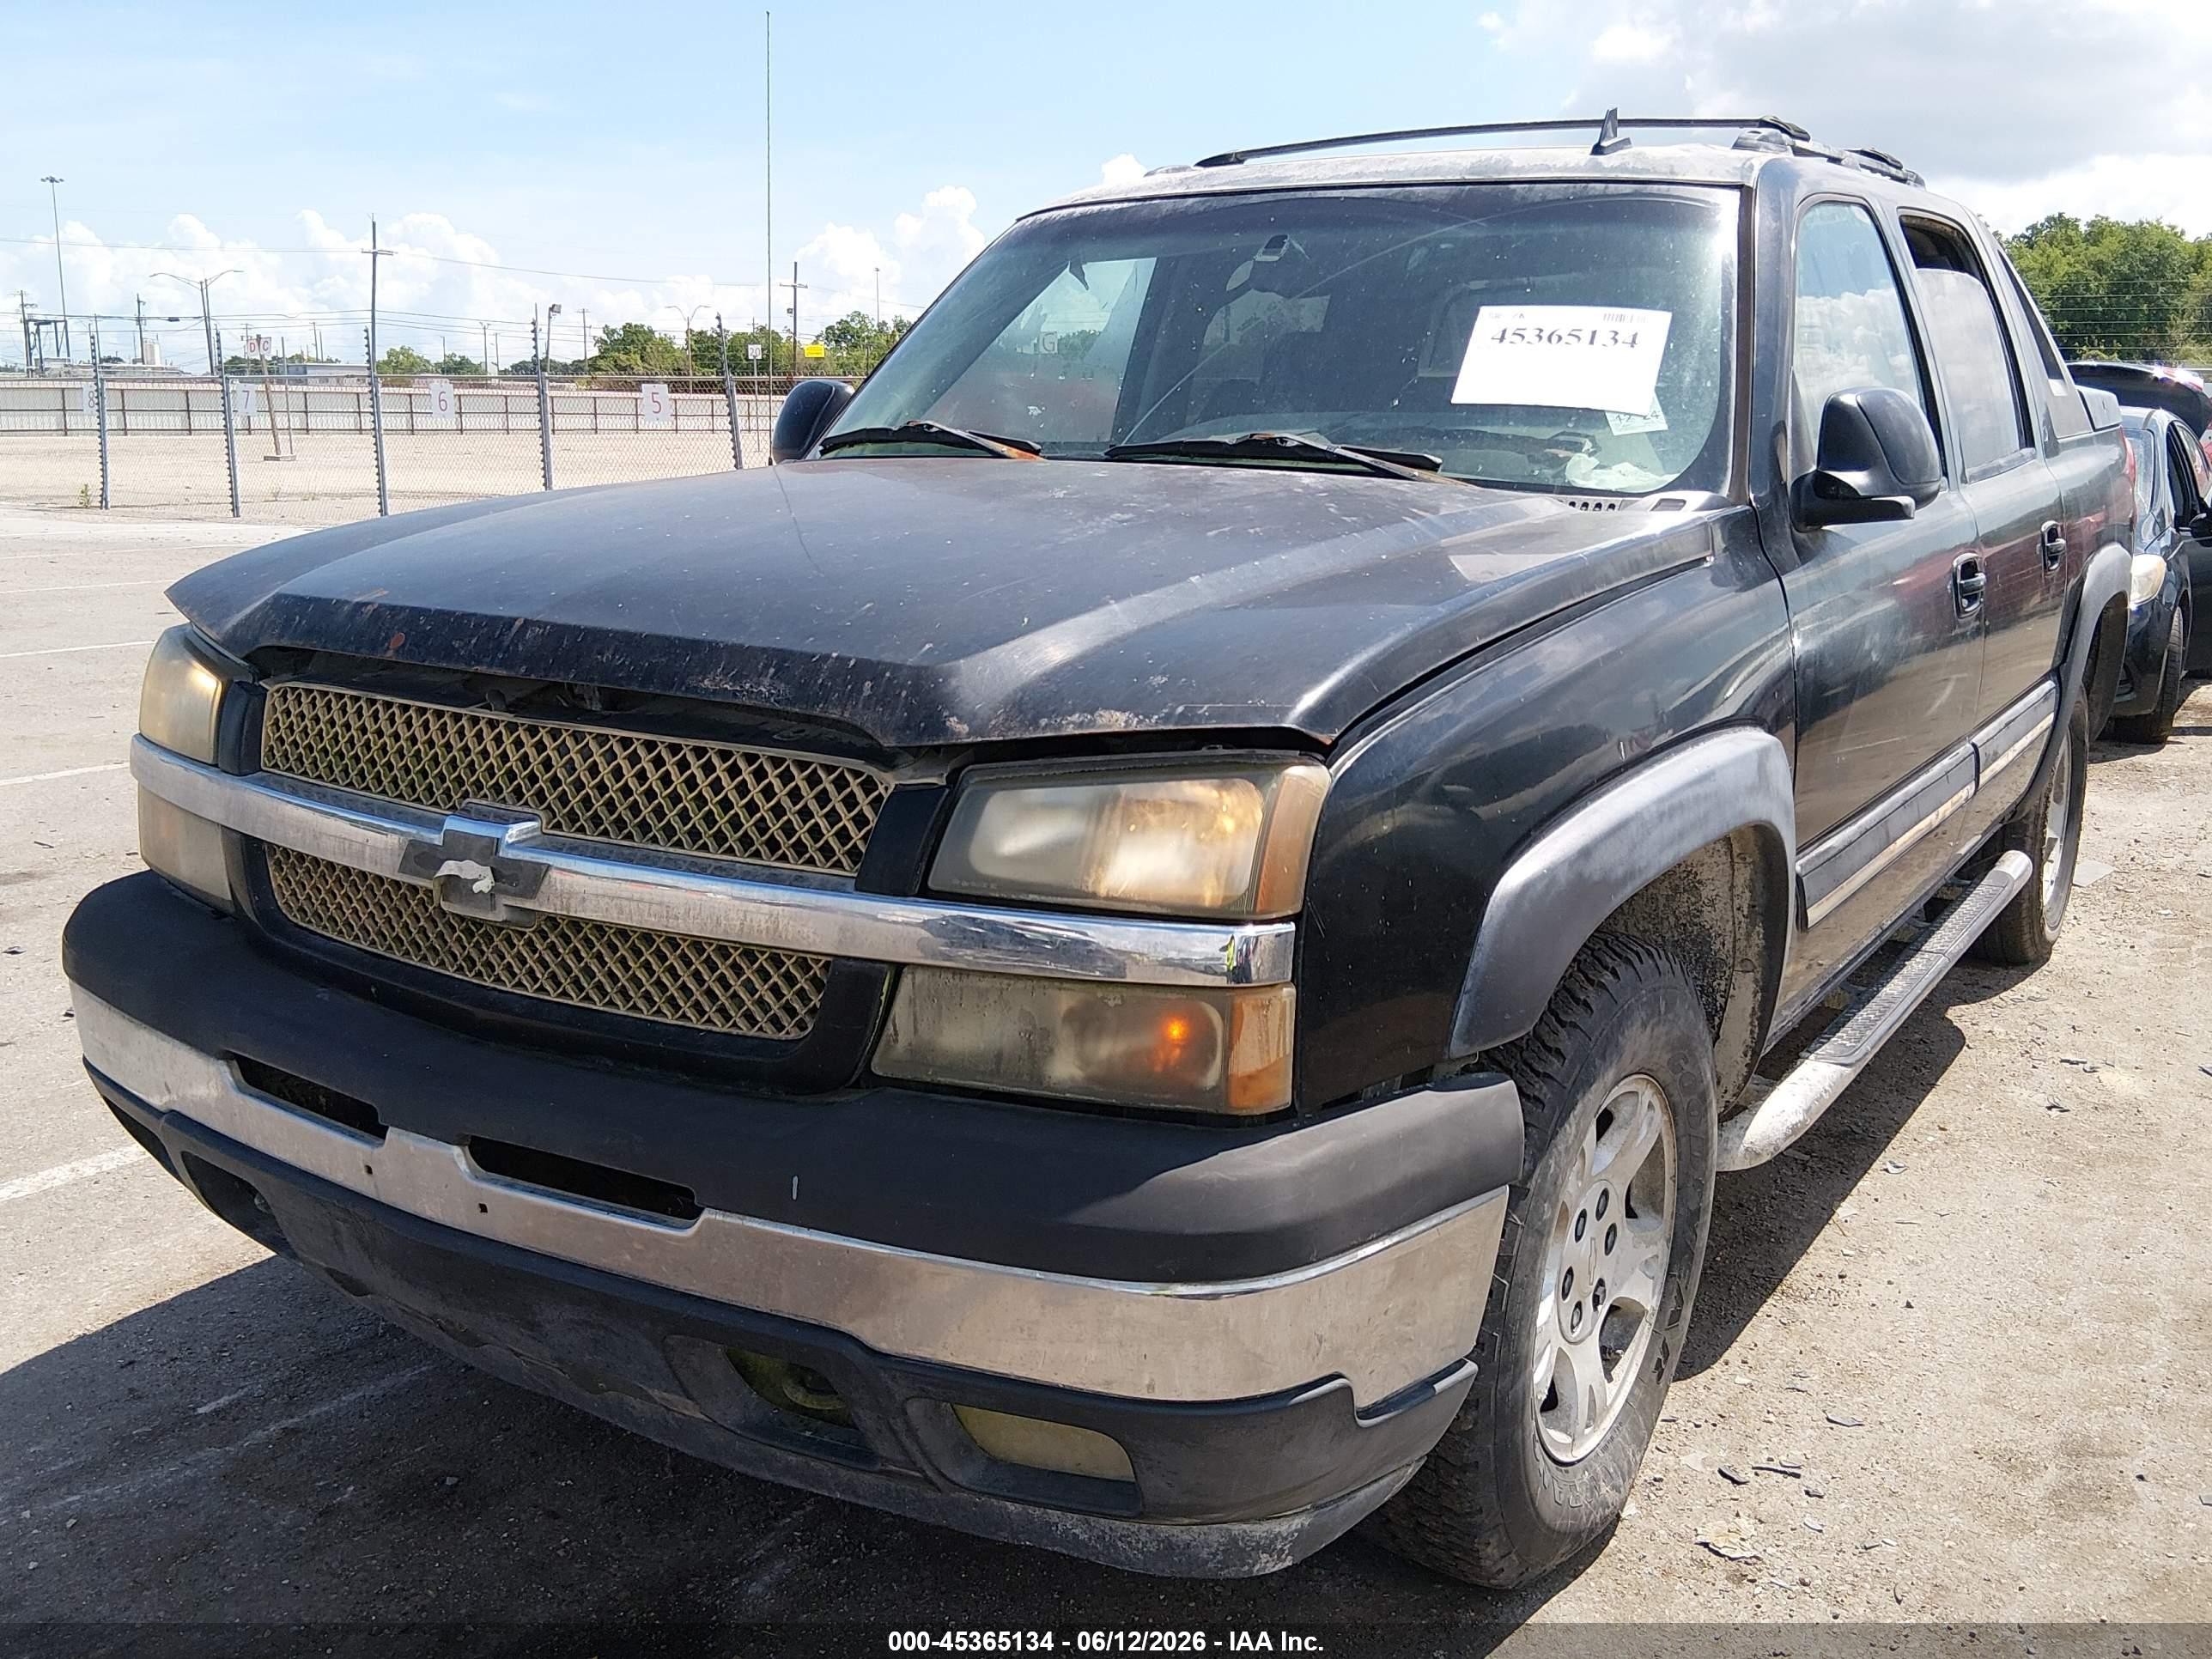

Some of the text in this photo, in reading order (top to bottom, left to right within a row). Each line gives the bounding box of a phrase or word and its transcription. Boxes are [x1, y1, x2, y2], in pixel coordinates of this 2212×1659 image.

[249, 341, 256, 354] D
[262, 340, 270, 352] C
[1042, 332, 1055, 352] G
[1491, 327, 1639, 349] 45365134
[88, 391, 95, 409] 8
[241, 390, 251, 409] 7
[438, 391, 448, 412] 6
[651, 392, 662, 414] 5
